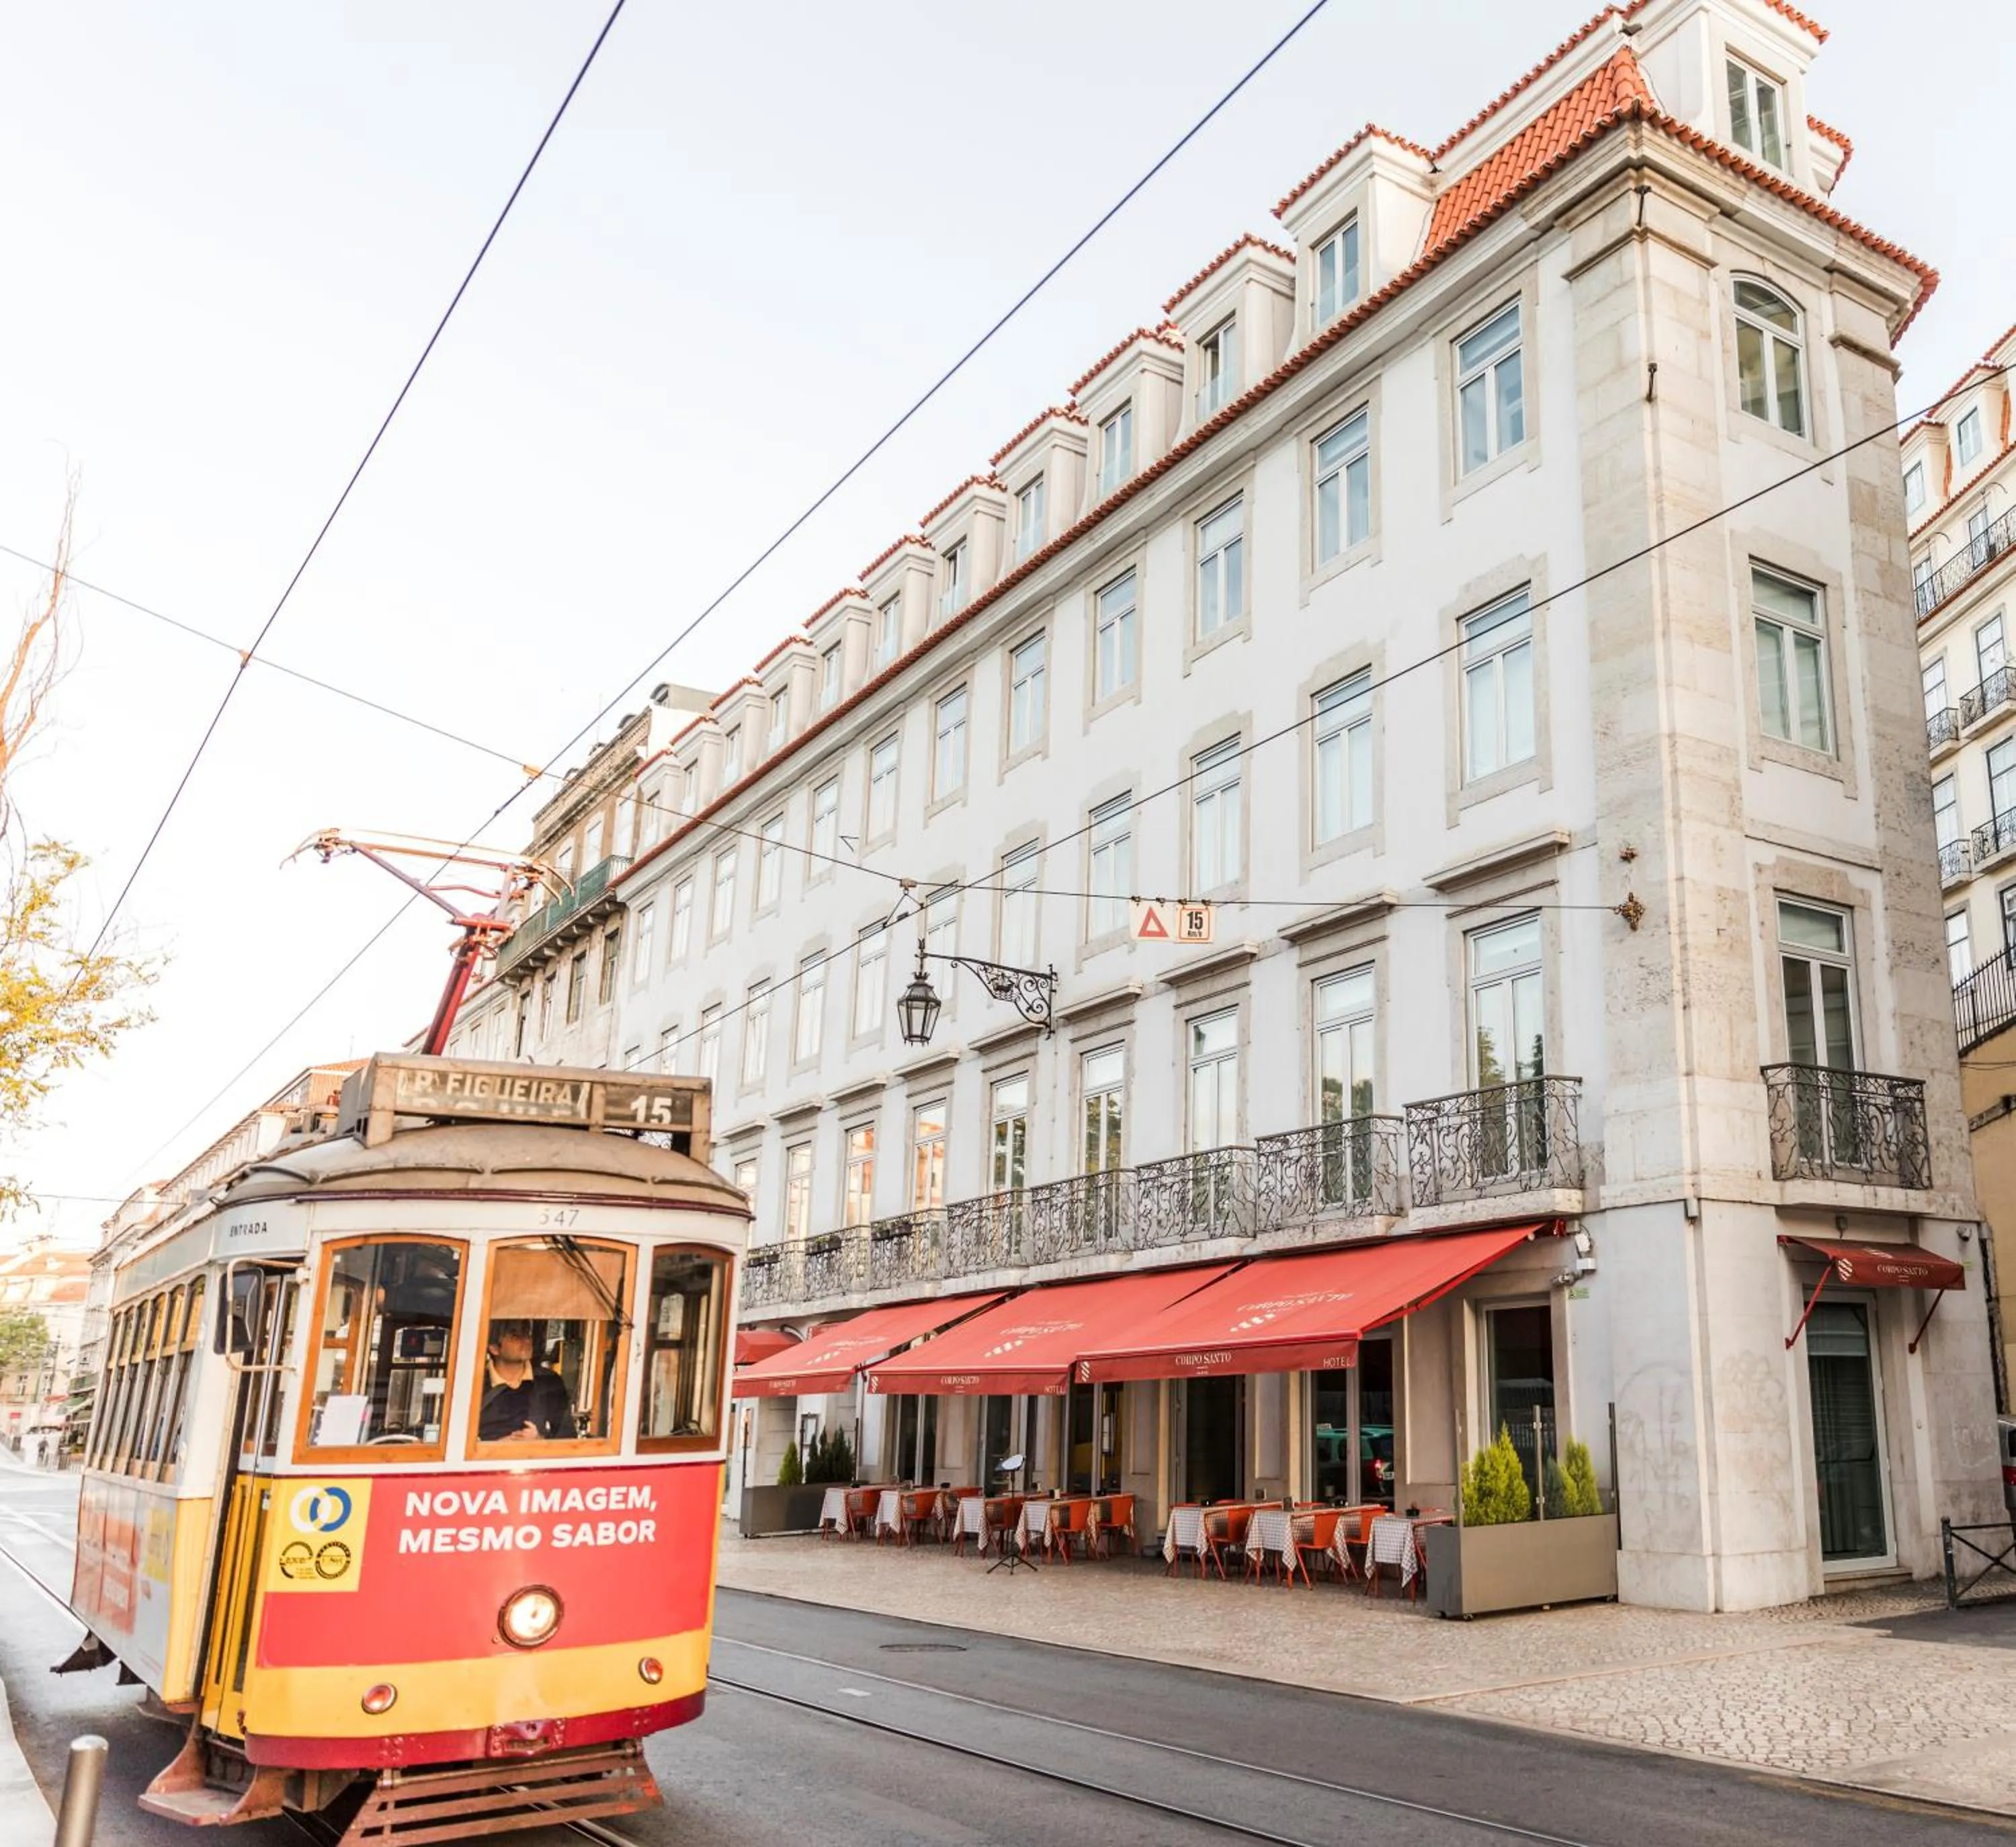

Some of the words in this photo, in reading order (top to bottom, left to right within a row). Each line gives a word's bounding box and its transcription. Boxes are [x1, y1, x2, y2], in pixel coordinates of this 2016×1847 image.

[1187, 911, 1203, 929] 15
[446, 1072, 573, 1104] FIGUEIRA
[630, 1095, 672, 1124] 15
[229, 1221, 267, 1237] ENTRADA
[1175, 1354, 1203, 1366] CORPO
[1204, 1352, 1232, 1364] SANTO
[1322, 1356, 1351, 1368] HOTEL
[405, 1490, 509, 1517] NOVA
[519, 1485, 657, 1513] IMAGEM,
[398, 1524, 542, 1553] MESMO
[551, 1519, 657, 1548] SABOR
